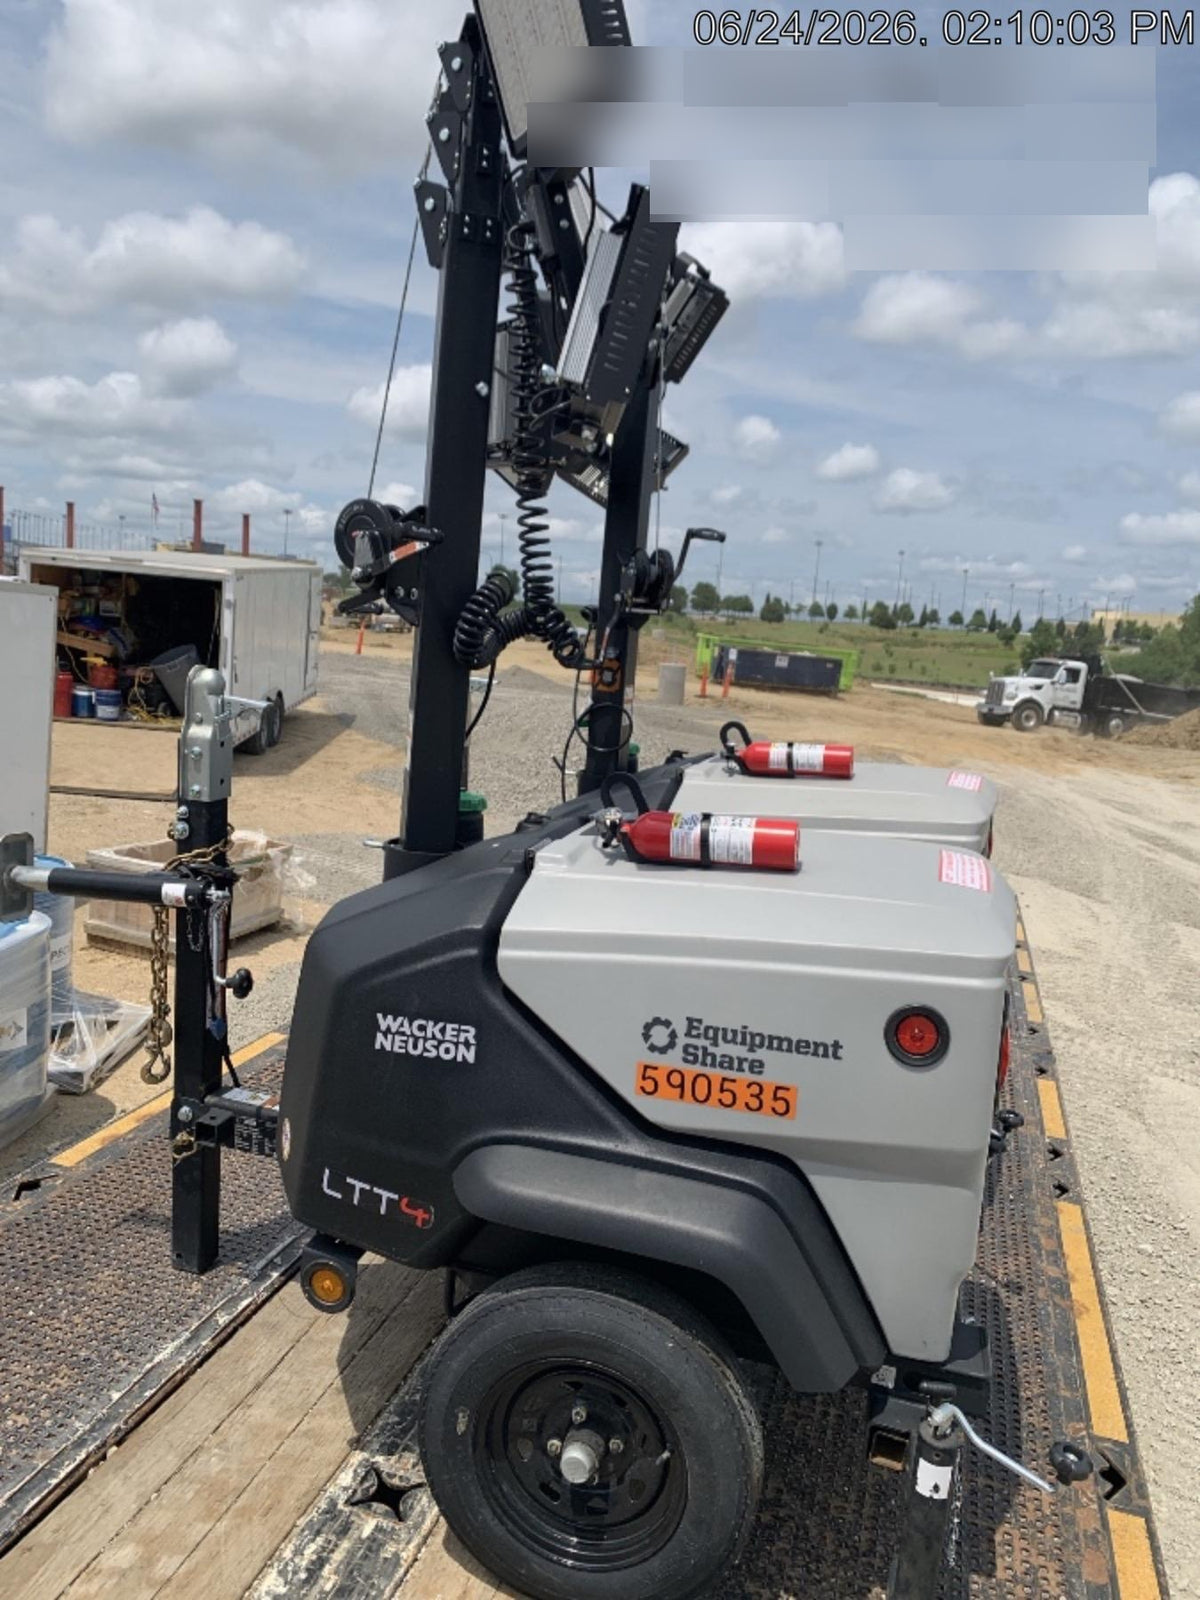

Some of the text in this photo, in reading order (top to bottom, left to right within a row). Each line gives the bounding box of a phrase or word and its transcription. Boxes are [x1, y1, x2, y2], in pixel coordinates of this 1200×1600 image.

[376, 1012, 477, 1044] WACKER
[684, 1016, 843, 1060] Equipment
[374, 1031, 476, 1064] NEUSON
[682, 1043, 765, 1075] Share
[639, 1064, 791, 1117] 590535
[322, 1166, 430, 1228] LTT4
